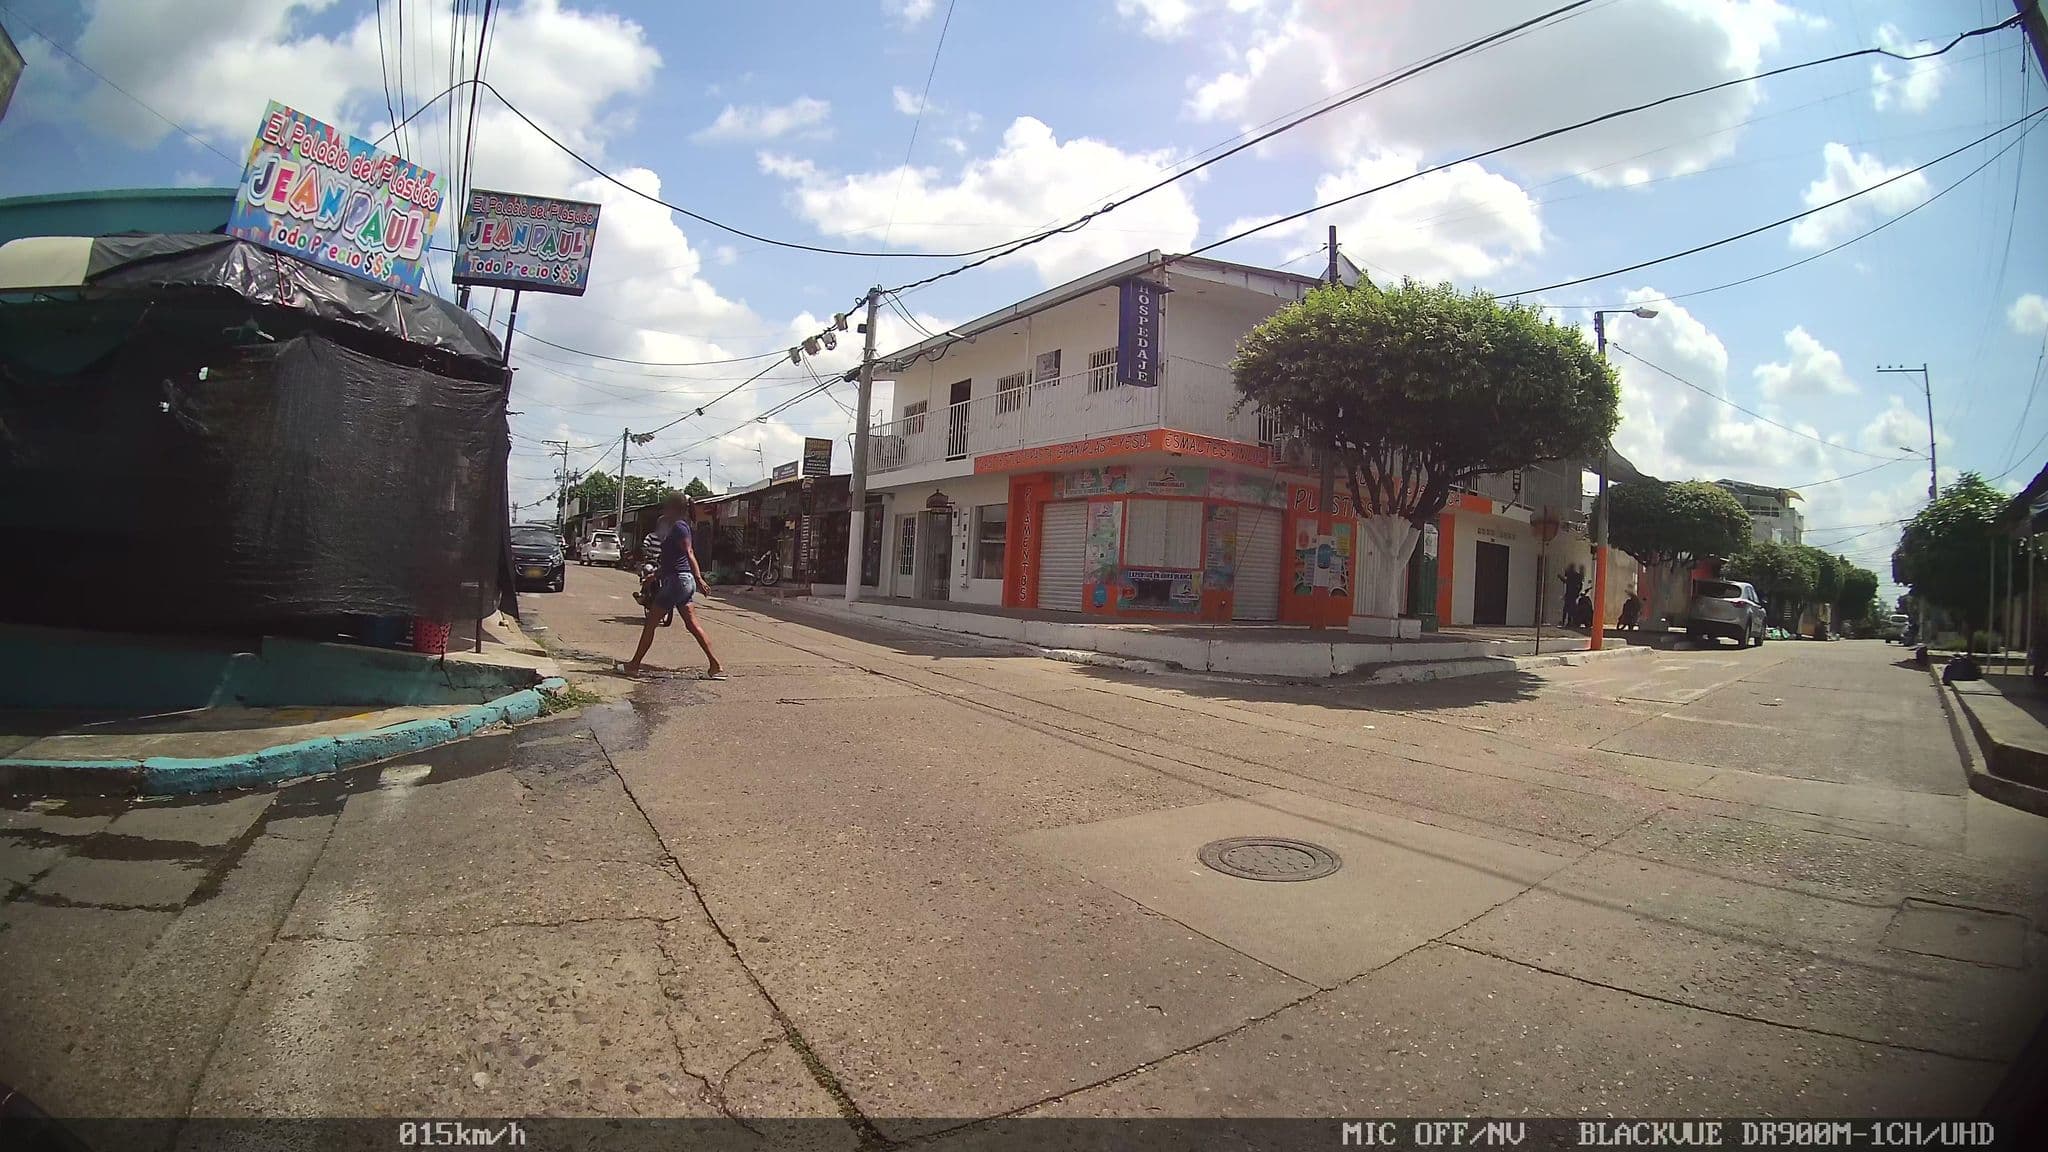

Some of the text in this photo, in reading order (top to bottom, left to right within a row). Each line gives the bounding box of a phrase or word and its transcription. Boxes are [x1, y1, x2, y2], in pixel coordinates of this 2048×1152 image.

[262, 111, 440, 211] El Palacio del Plástico
[248, 153, 424, 261] JEAN PAUL
[466, 217, 586, 261] JEAN PAUL
[471, 195, 488, 213] El
[487, 196, 528, 218] Palacio
[529, 203, 547, 219] del
[269, 218, 394, 282] Todo Precio $$$
[469, 257, 579, 284] Todo Precio $$$
[1137, 284, 1150, 382] HOSPEDAJE
